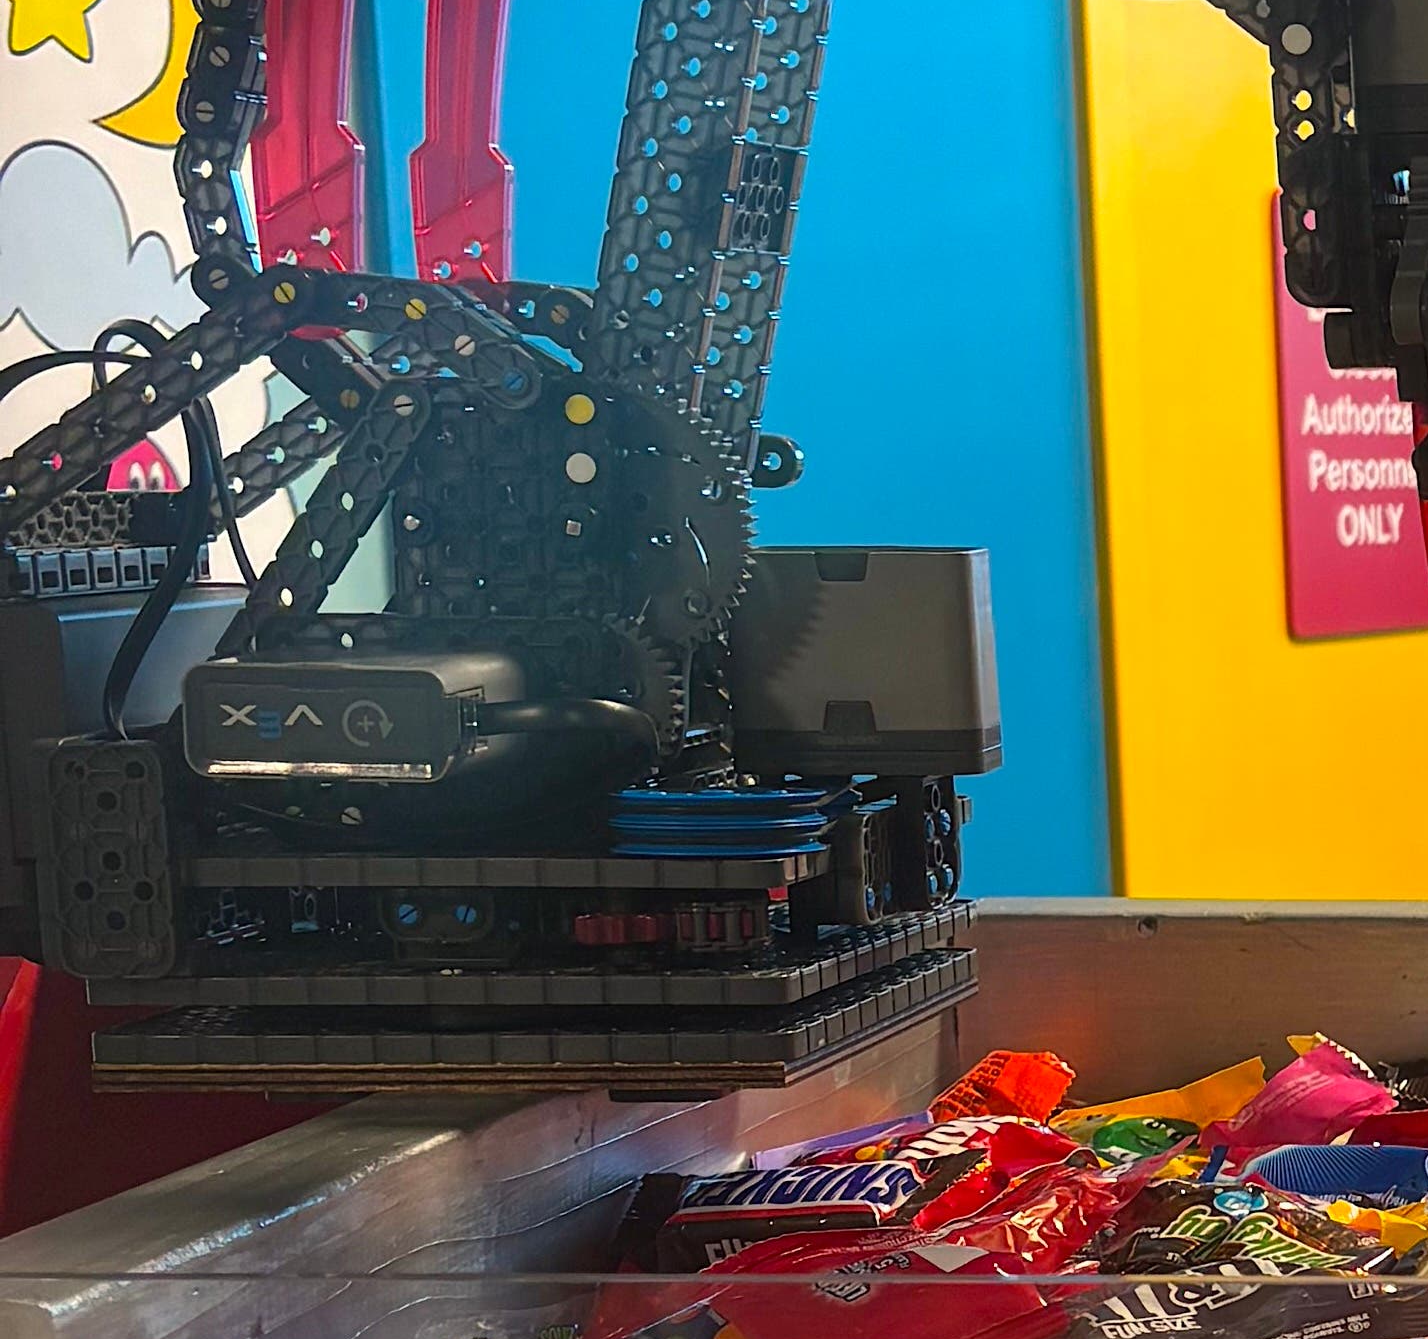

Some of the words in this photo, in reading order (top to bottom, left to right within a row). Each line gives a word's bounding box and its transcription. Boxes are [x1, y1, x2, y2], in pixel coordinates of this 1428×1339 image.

[1301, 393, 1413, 436] Authorize
[1337, 503, 1404, 547] ONLY
[683, 1162, 924, 1208] SNICKE
